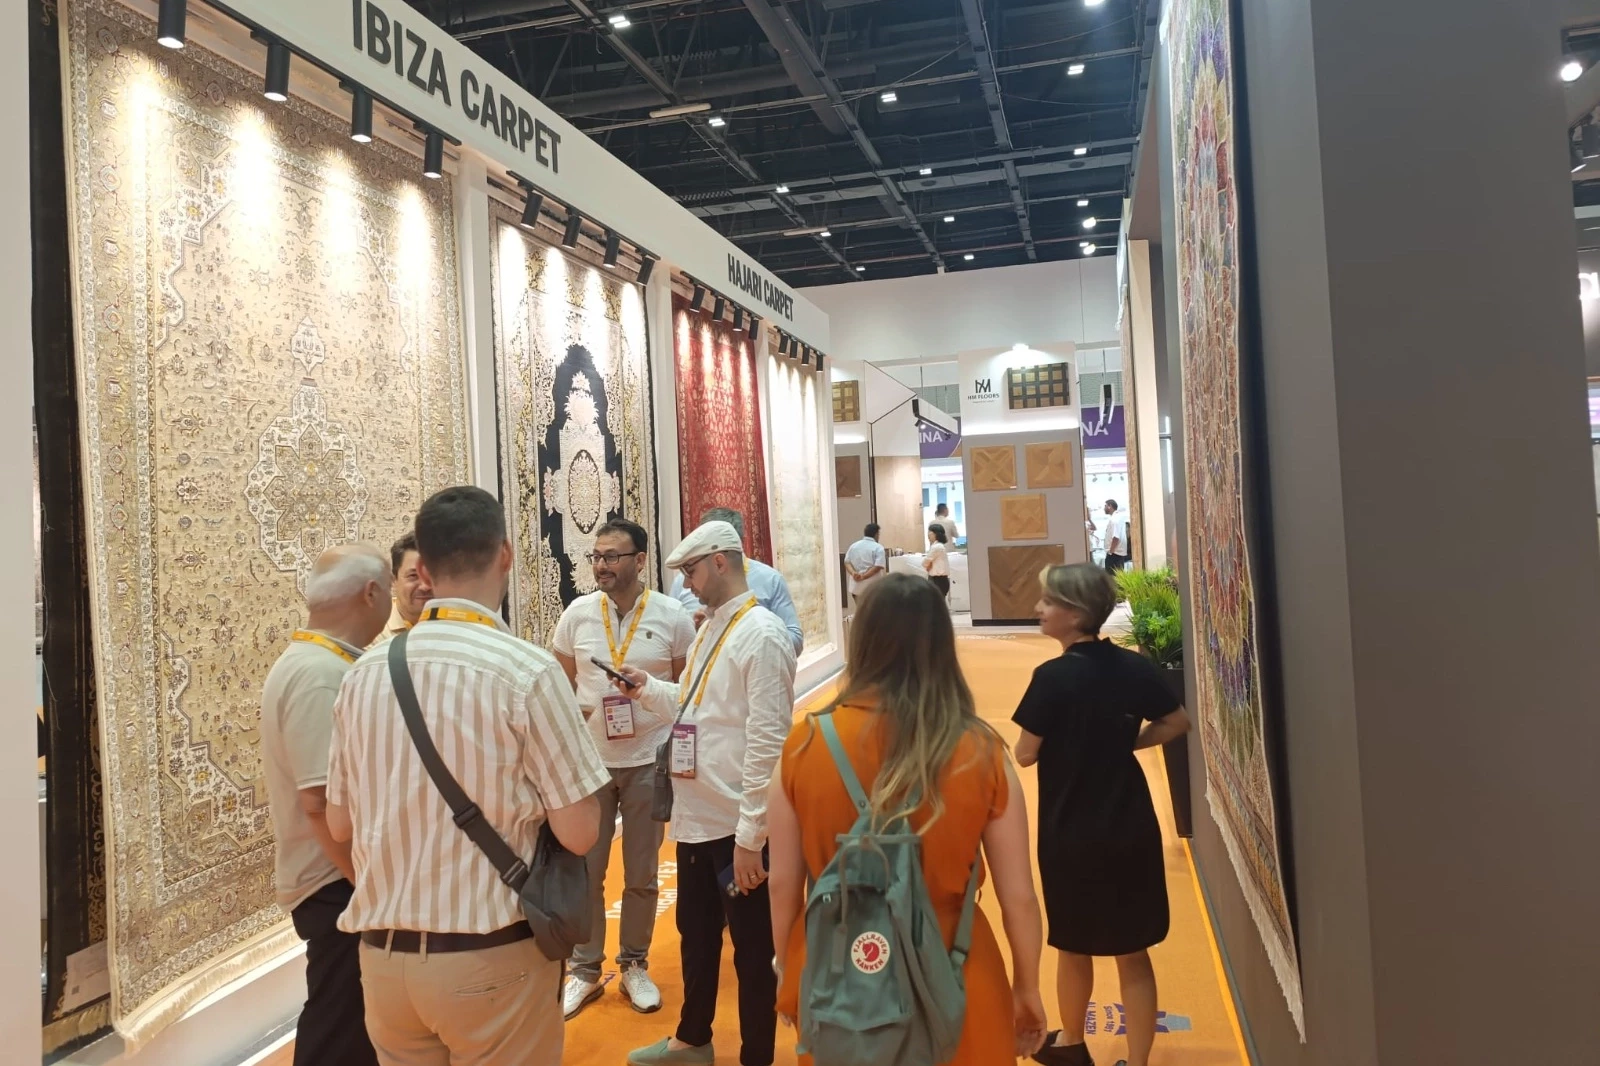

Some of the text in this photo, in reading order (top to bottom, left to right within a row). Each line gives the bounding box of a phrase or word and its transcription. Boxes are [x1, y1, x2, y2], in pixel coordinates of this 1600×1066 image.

[352, 0, 561, 174] IBIZA CARPET
[727, 252, 794, 322] HAJARI CARPET
[977, 392, 1000, 400] FLOORS
